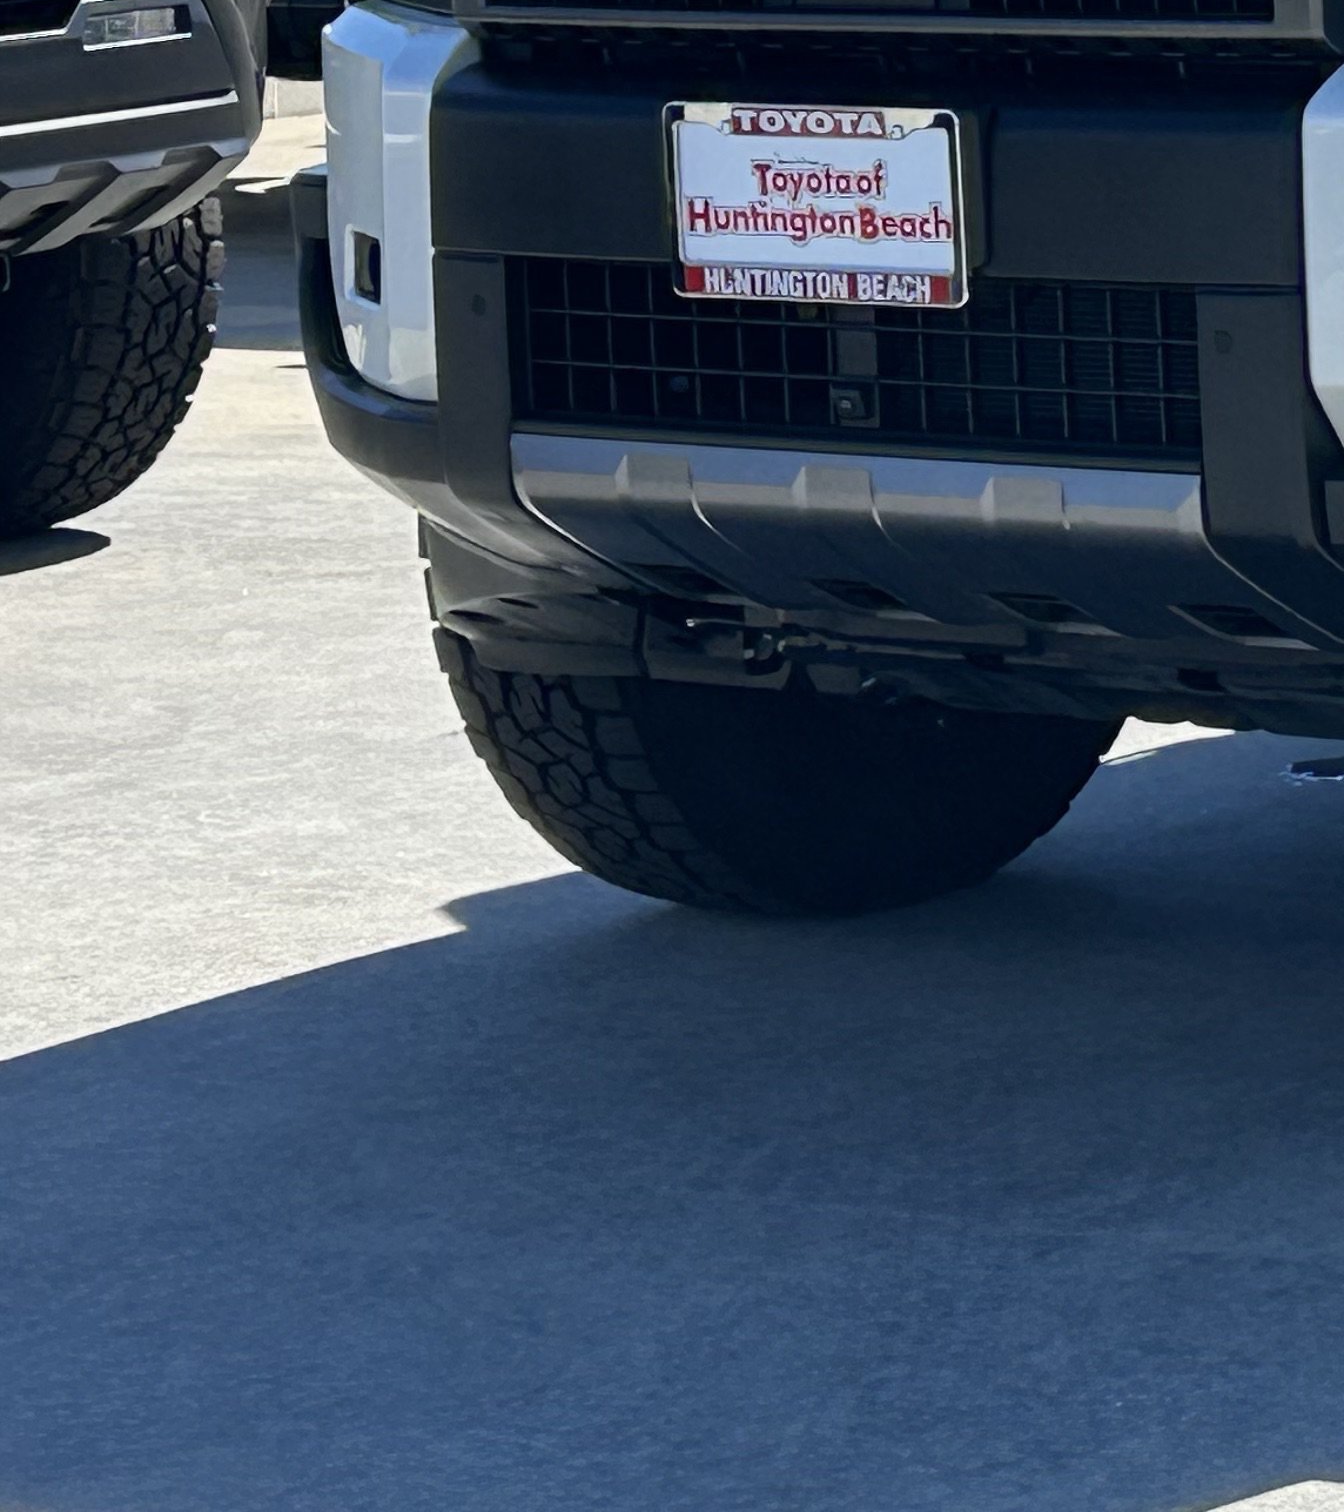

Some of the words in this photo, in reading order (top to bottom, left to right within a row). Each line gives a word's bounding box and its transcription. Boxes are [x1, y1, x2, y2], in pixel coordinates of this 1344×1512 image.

[734, 110, 882, 134] TOYOTA
[752, 162, 851, 200] Toyota
[854, 160, 886, 195] of
[688, 199, 859, 241] Huntington
[859, 203, 954, 239] Beach
[704, 267, 849, 299] HUNTINGTON
[856, 273, 931, 304] BEACH
